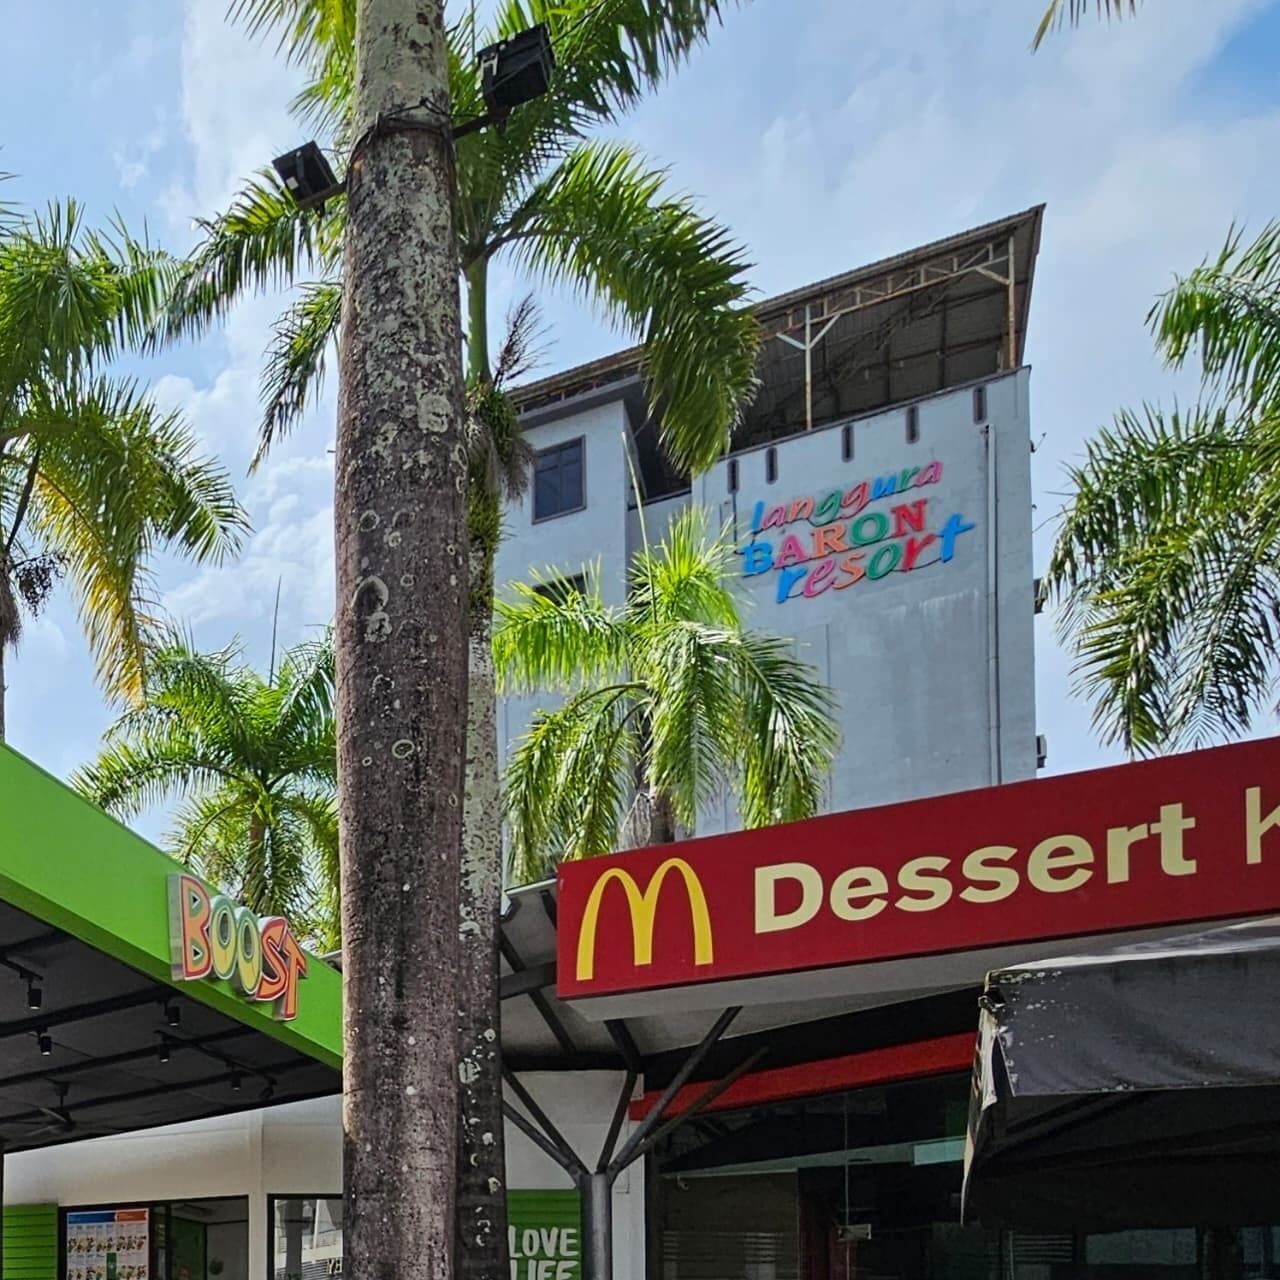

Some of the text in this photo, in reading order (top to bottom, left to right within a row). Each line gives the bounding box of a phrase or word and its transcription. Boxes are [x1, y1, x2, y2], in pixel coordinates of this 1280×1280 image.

[742, 498, 929, 577] BARON
[752, 461, 944, 534] langgura
[775, 512, 975, 604] resort
[754, 802, 1198, 934] Dessert
[177, 874, 308, 1021] BOOST
[507, 1224, 579, 1258] LOVE
